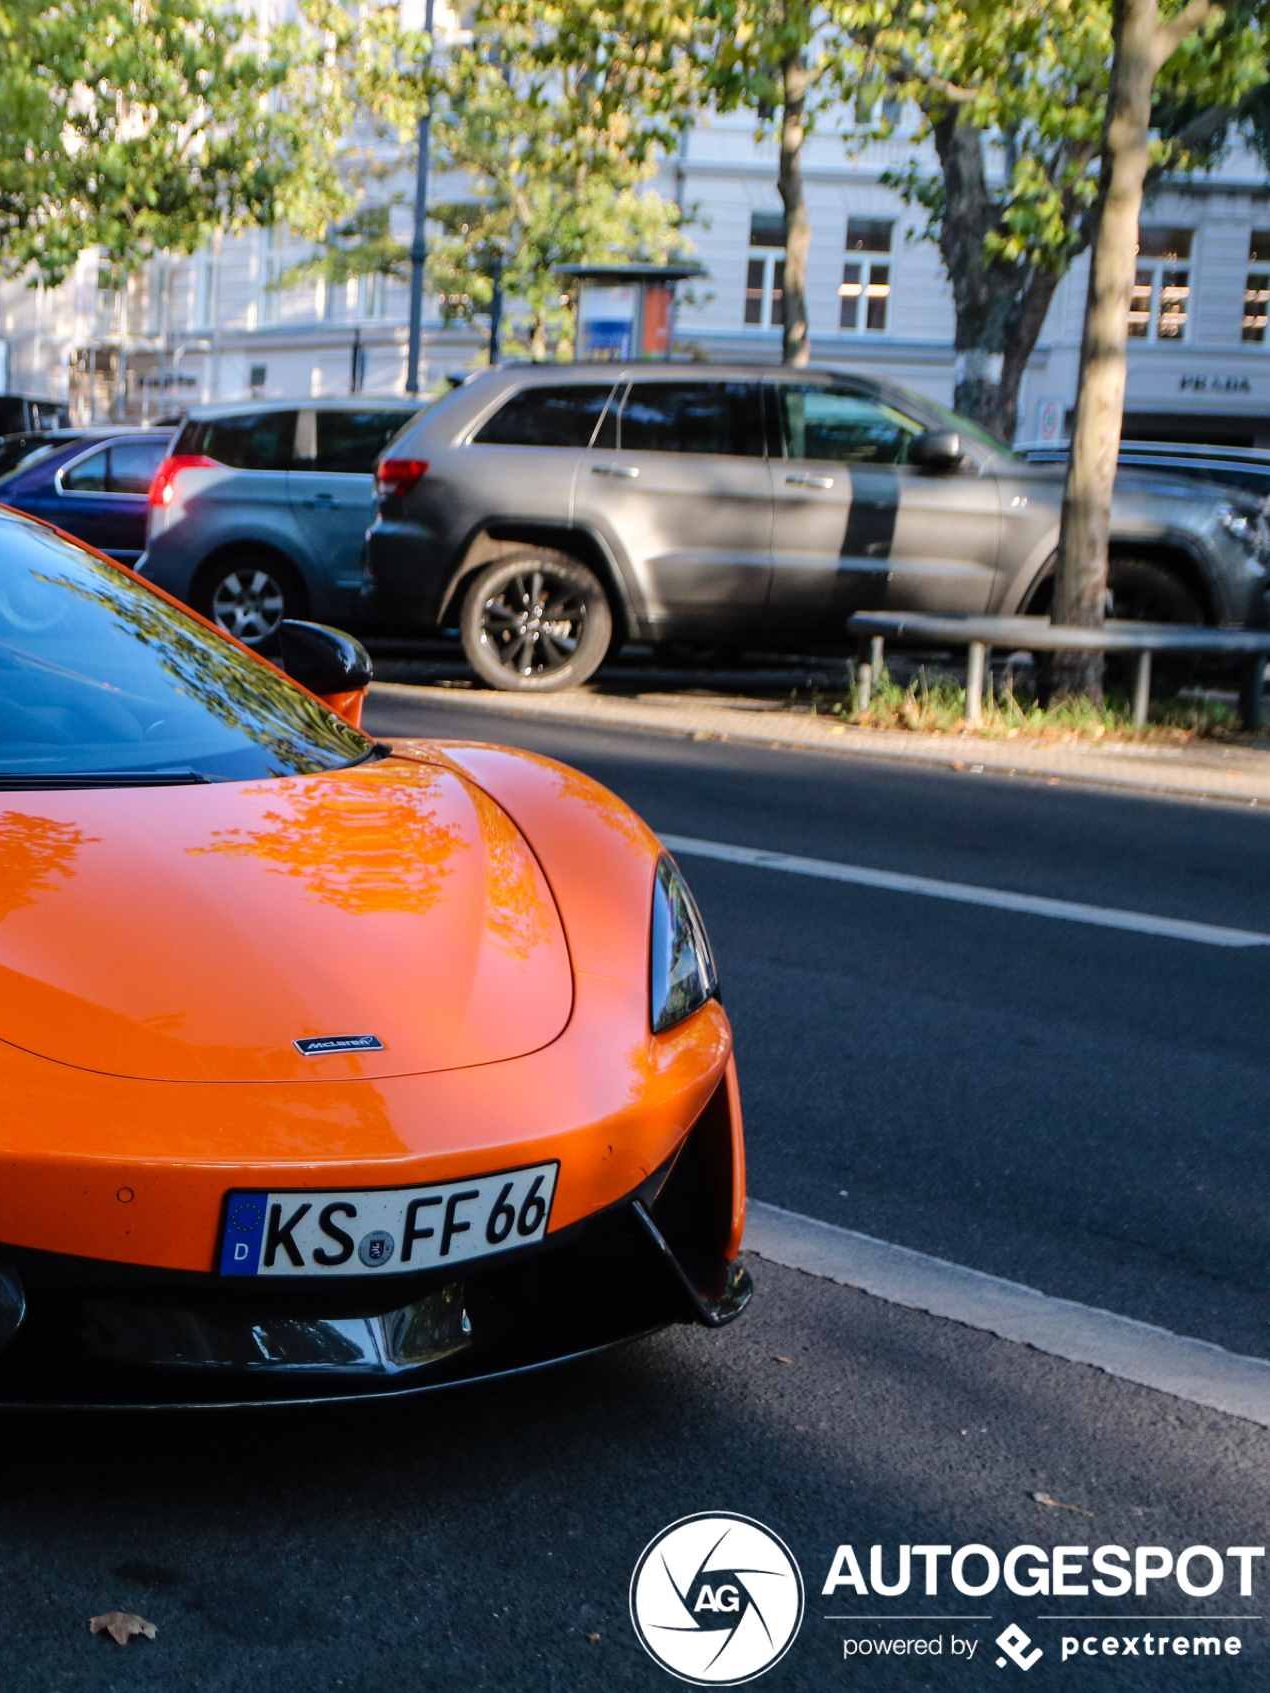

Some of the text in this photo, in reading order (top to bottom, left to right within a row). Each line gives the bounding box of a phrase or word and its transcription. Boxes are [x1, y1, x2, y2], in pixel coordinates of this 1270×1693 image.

[306, 1039, 371, 1050] McLaren
[263, 1175, 546, 1267] KS FF 66
[234, 1243, 249, 1261] D
